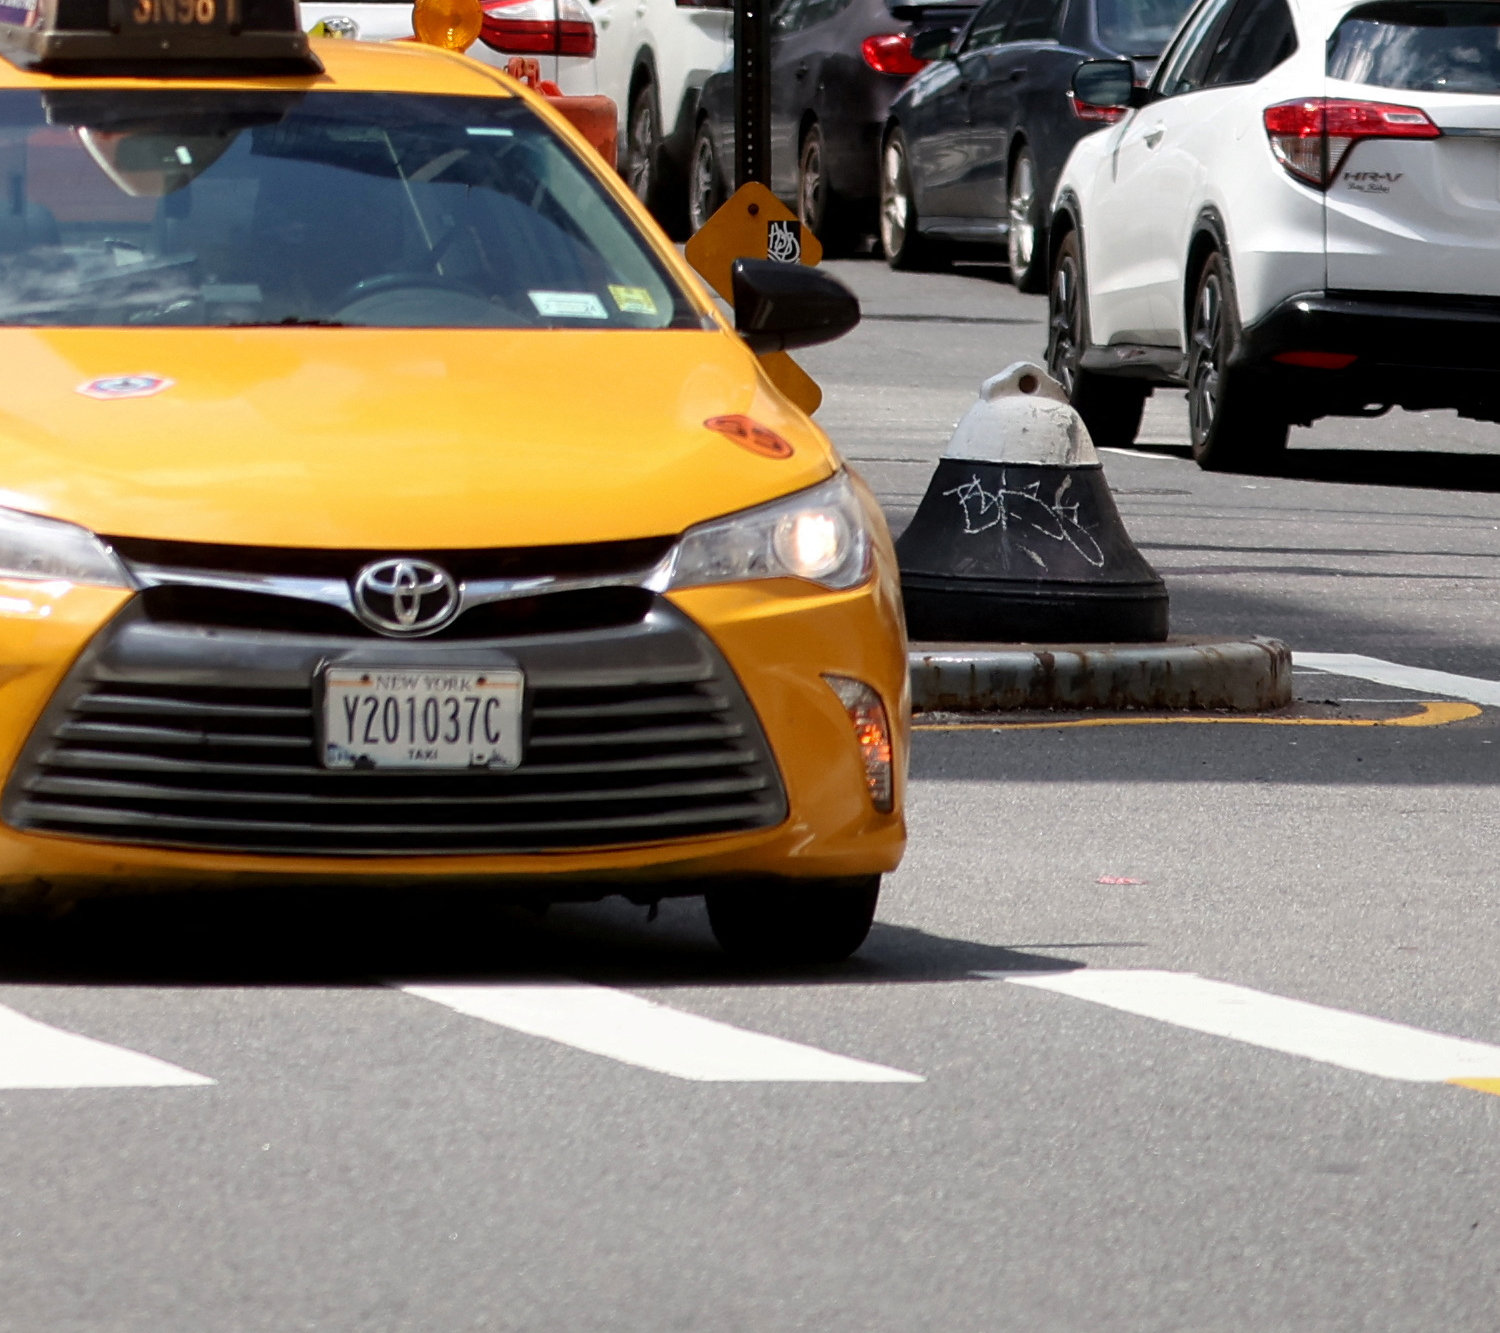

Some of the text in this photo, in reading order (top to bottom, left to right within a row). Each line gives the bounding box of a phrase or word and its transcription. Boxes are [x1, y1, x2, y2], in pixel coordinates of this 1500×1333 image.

[1343, 171, 1403, 182] HR-V
[375, 674, 473, 692] NEW YORK
[342, 695, 501, 744] Y201037C
[408, 748, 439, 760] TAXI
